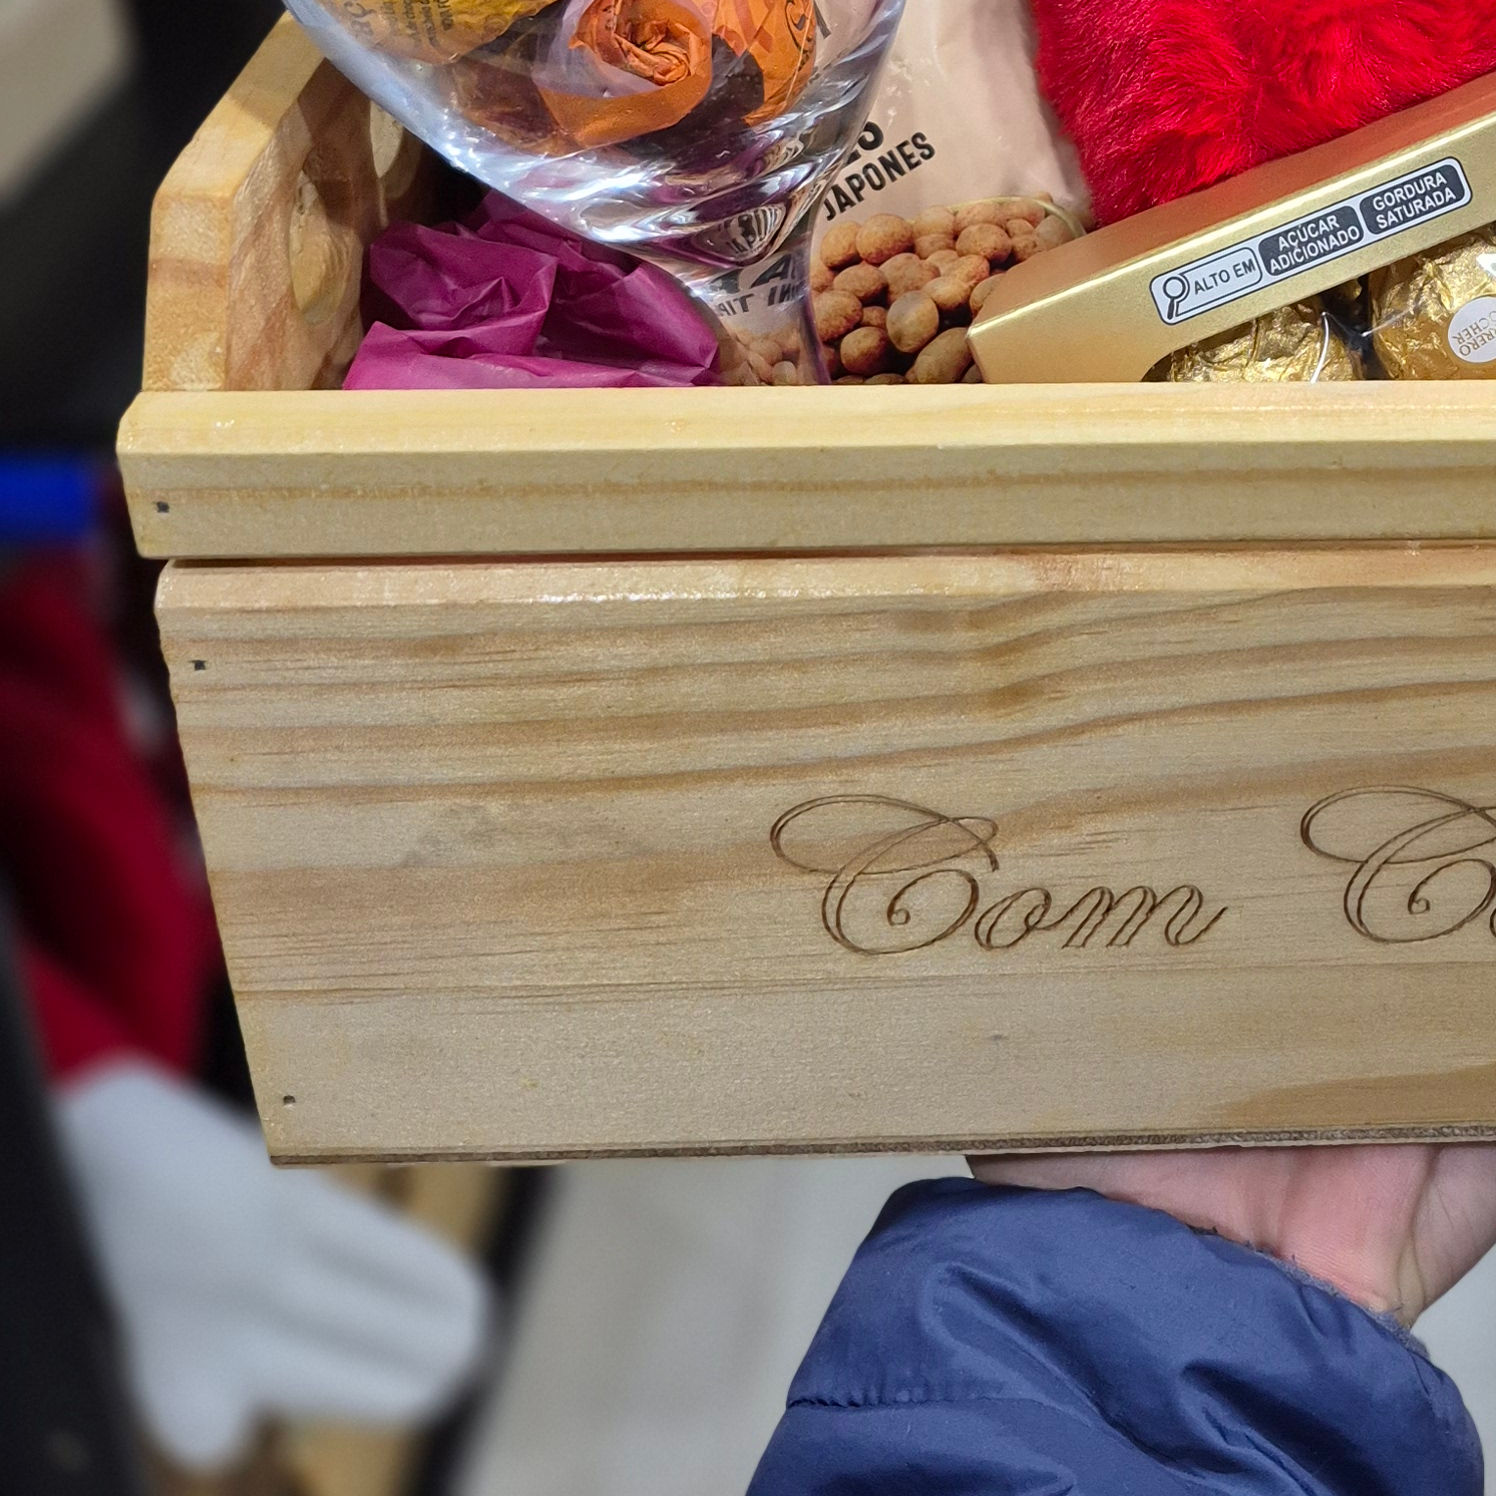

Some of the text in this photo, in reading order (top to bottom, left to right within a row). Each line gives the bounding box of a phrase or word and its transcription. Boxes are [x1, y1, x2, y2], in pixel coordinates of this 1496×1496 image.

[823, 131, 936, 222] JAPONES
[1372, 171, 1448, 212] GORDURA
[1375, 187, 1457, 230] SATURADA
[1268, 225, 1360, 274] ADICIONADO
[1277, 213, 1341, 253] AÇÚCAR
[1193, 257, 1256, 296] ALTO EM
[769, 792, 1232, 956] Com
